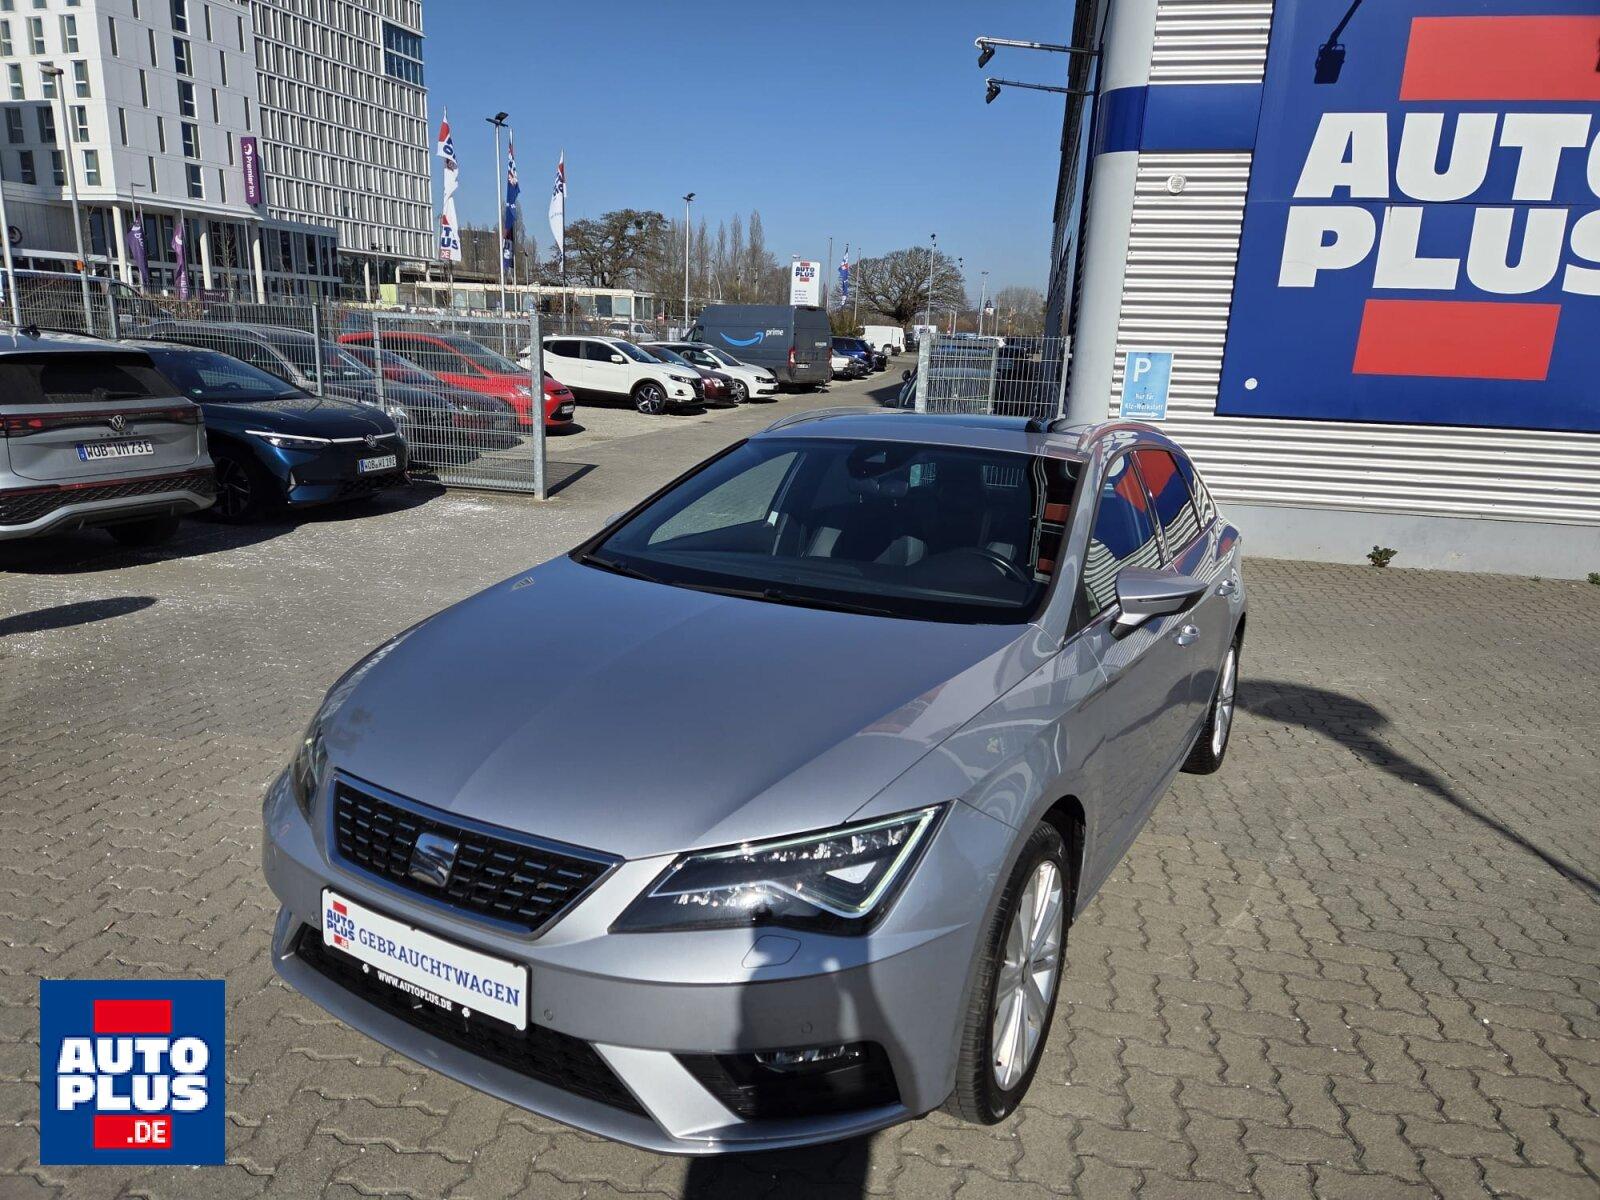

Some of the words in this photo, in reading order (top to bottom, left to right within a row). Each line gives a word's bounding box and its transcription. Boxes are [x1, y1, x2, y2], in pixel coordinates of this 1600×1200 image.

[1293, 112, 1600, 202] AUT
[765, 328, 784, 337] prime
[1133, 357, 1152, 382] P
[84, 443, 109, 458] WOB
[327, 909, 355, 931] AUTO
[327, 921, 355, 941] PLUS
[359, 928, 520, 1007] GEBRAUCHTWAGEN
[377, 970, 452, 1011] WWW.AUTOPLUS.DE
